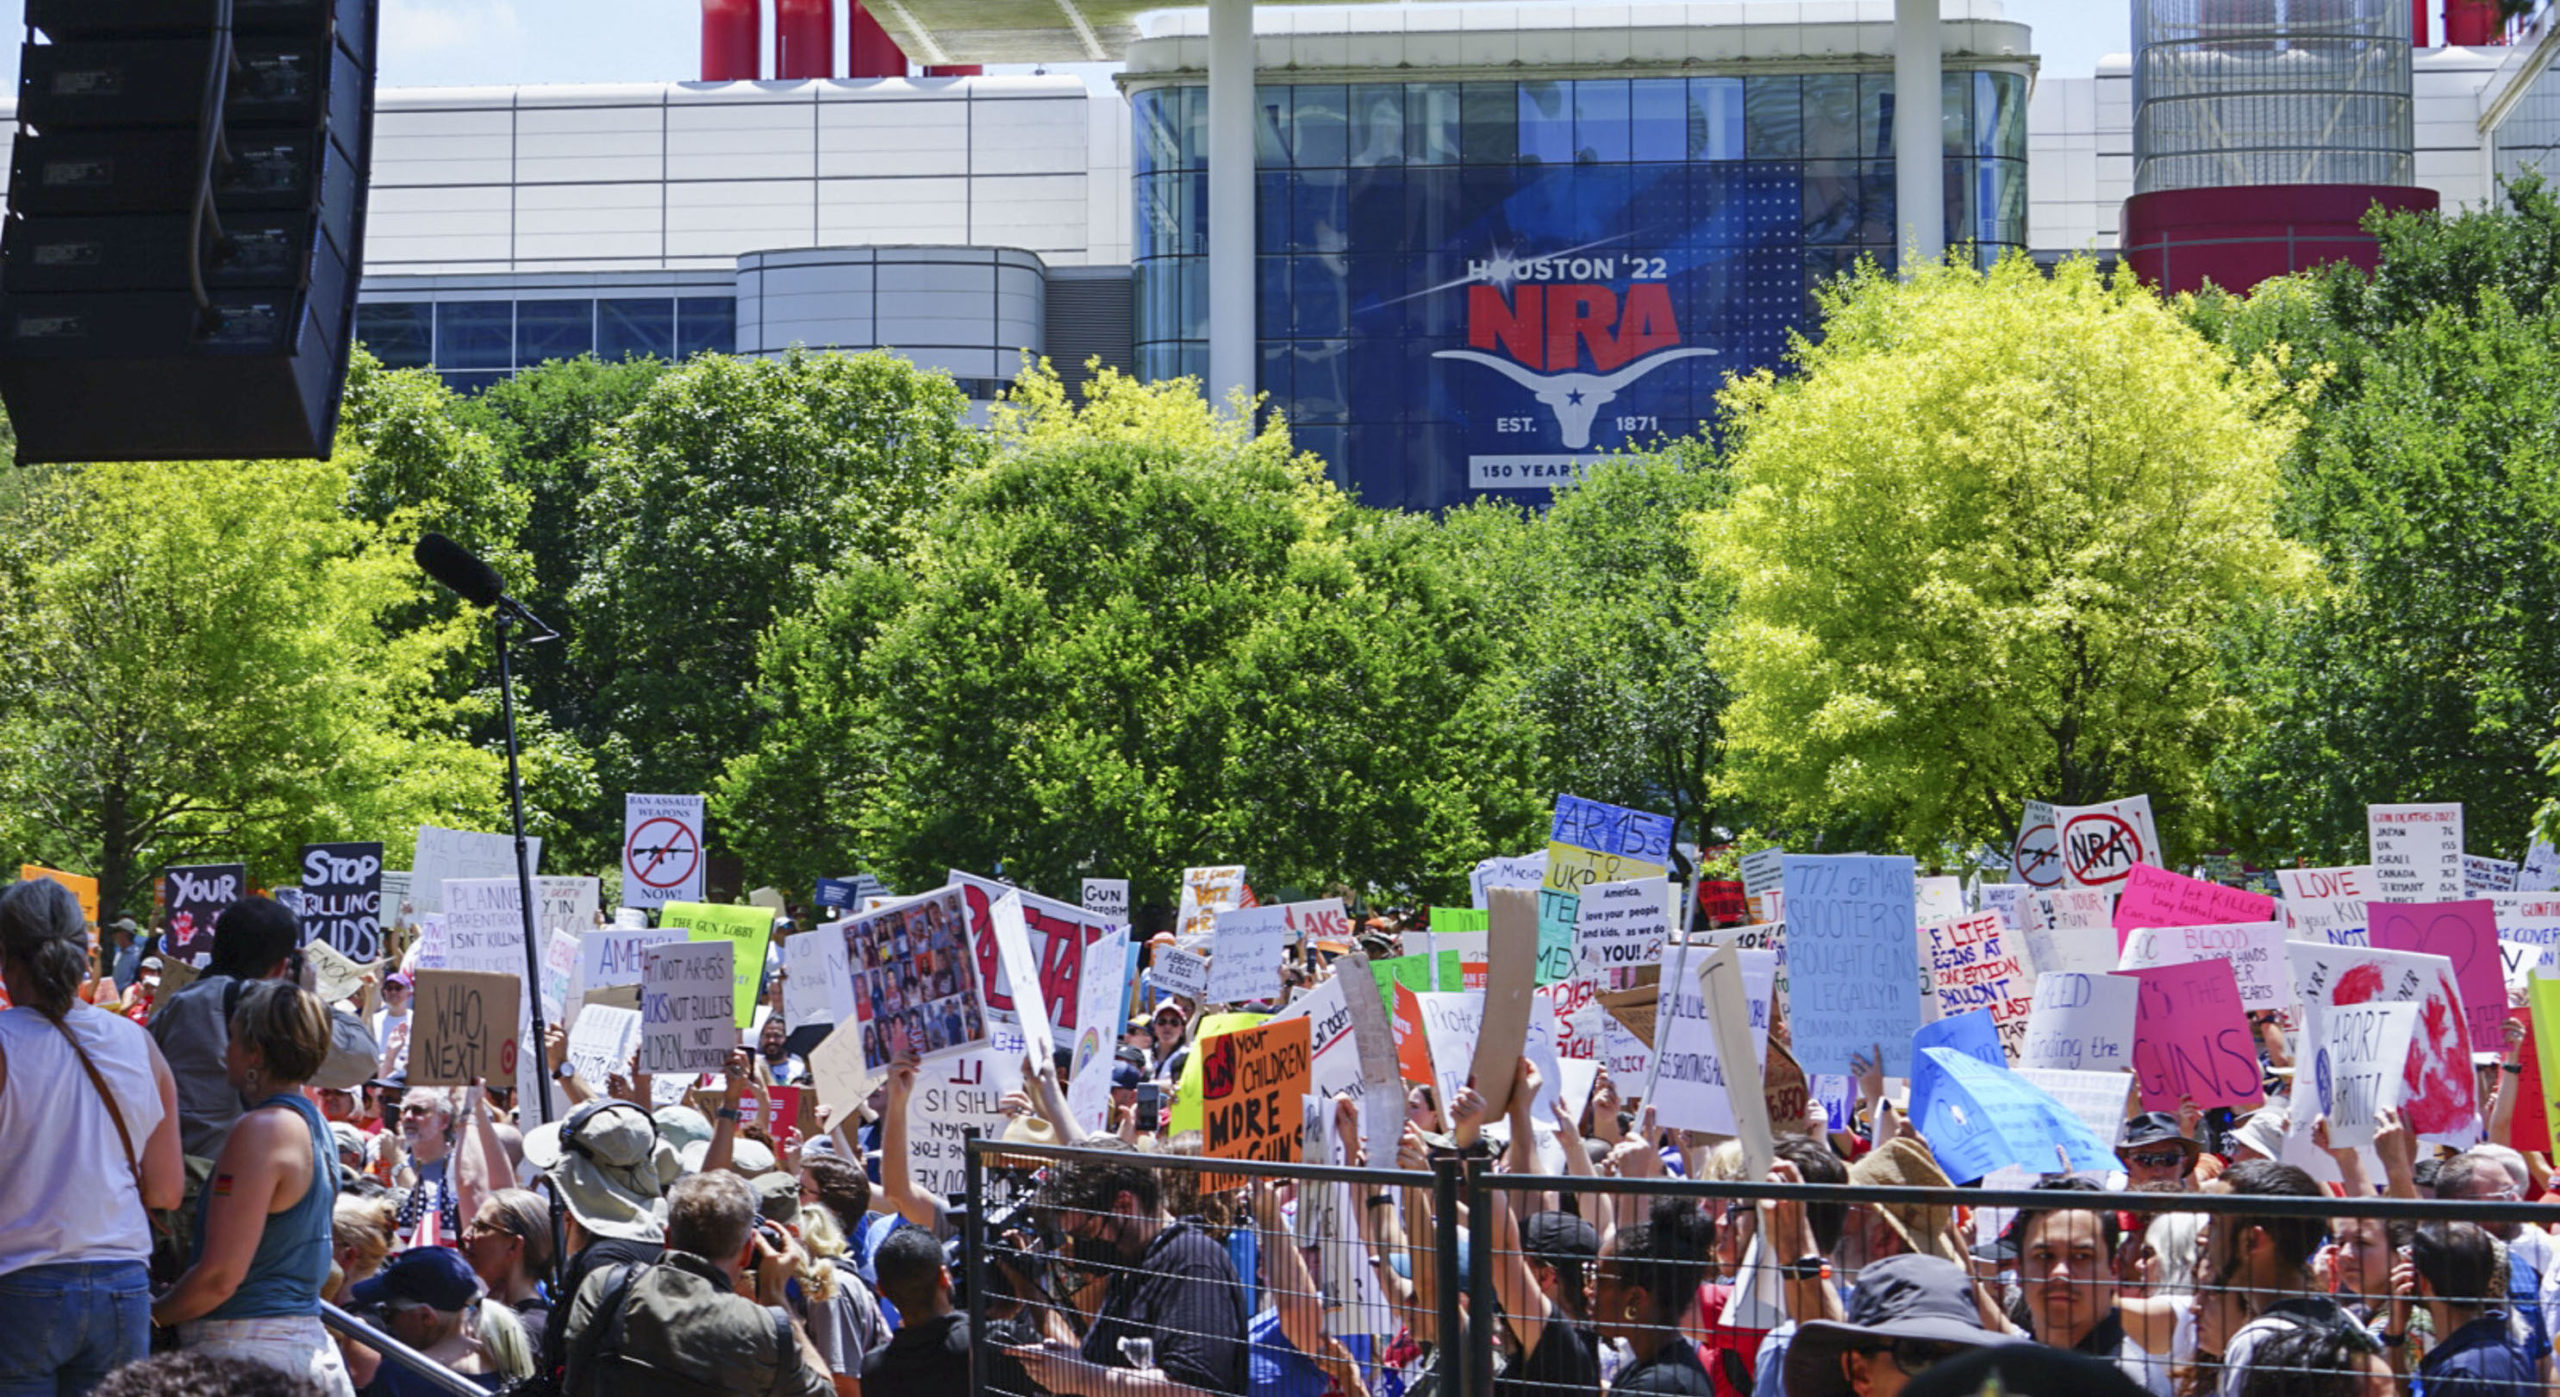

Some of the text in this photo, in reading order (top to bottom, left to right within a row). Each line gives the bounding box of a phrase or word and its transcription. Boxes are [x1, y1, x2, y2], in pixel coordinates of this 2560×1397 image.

[1467, 283, 1682, 373] NRA
[1496, 416, 1659, 433] EST. 1871
[1482, 464, 1513, 478] 150
[628, 796, 701, 807] BAN ASSAULT
[637, 808, 691, 817] WEAPONS
[2376, 827, 2407, 837] JAPAN
[2069, 824, 2133, 870] NRA
[2376, 840, 2393, 851] UK
[302, 849, 381, 887] STOP
[1585, 851, 1621, 875] TO
[2377, 869, 2418, 879] CANADA
[170, 871, 238, 909] YOUR
[1791, 864, 1841, 896] 77%
[1848, 876, 1868, 896] OF
[1868, 860, 1912, 899] MASS
[2132, 867, 2176, 893] Don't
[2182, 883, 2203, 899] let
[2292, 870, 2362, 899] LOVE
[302, 890, 381, 917] KILLING
[451, 885, 523, 912] PLANNE
[640, 887, 684, 900] NOW!
[1084, 885, 1121, 902] GUN
[1603, 886, 1642, 899] America,
[1585, 904, 1660, 922] love your people
[1787, 897, 1907, 944] SHOOTERS
[2298, 913, 2332, 936] your
[304, 915, 381, 963] KIDS
[671, 917, 758, 938] THE GUN LOBBY
[1582, 923, 1666, 939] and kids, as we do
[1948, 915, 2001, 948] LIFE
[2183, 927, 2249, 950] BLOOD
[2325, 927, 2370, 948] NOT
[1164, 951, 1203, 970] ABBOTT
[1602, 943, 1642, 963] YOU!
[1790, 940, 1919, 982] BOUGHT GUNS
[1983, 938, 2003, 961] AT
[2235, 947, 2270, 963] HANDS
[2183, 976, 2227, 1007] THE
[434, 984, 482, 1042] WHO
[2091, 1035, 2120, 1059] the
[2331, 1010, 2392, 1064] ABORT
[949, 1058, 983, 1085] IT
[1242, 1039, 1308, 1094] CHILDREN
[2133, 1028, 2260, 1098] GUNS
[925, 1088, 1001, 1115] THIS IS
[1209, 1089, 1281, 1151] MORE
[911, 1141, 941, 1159] FOR
